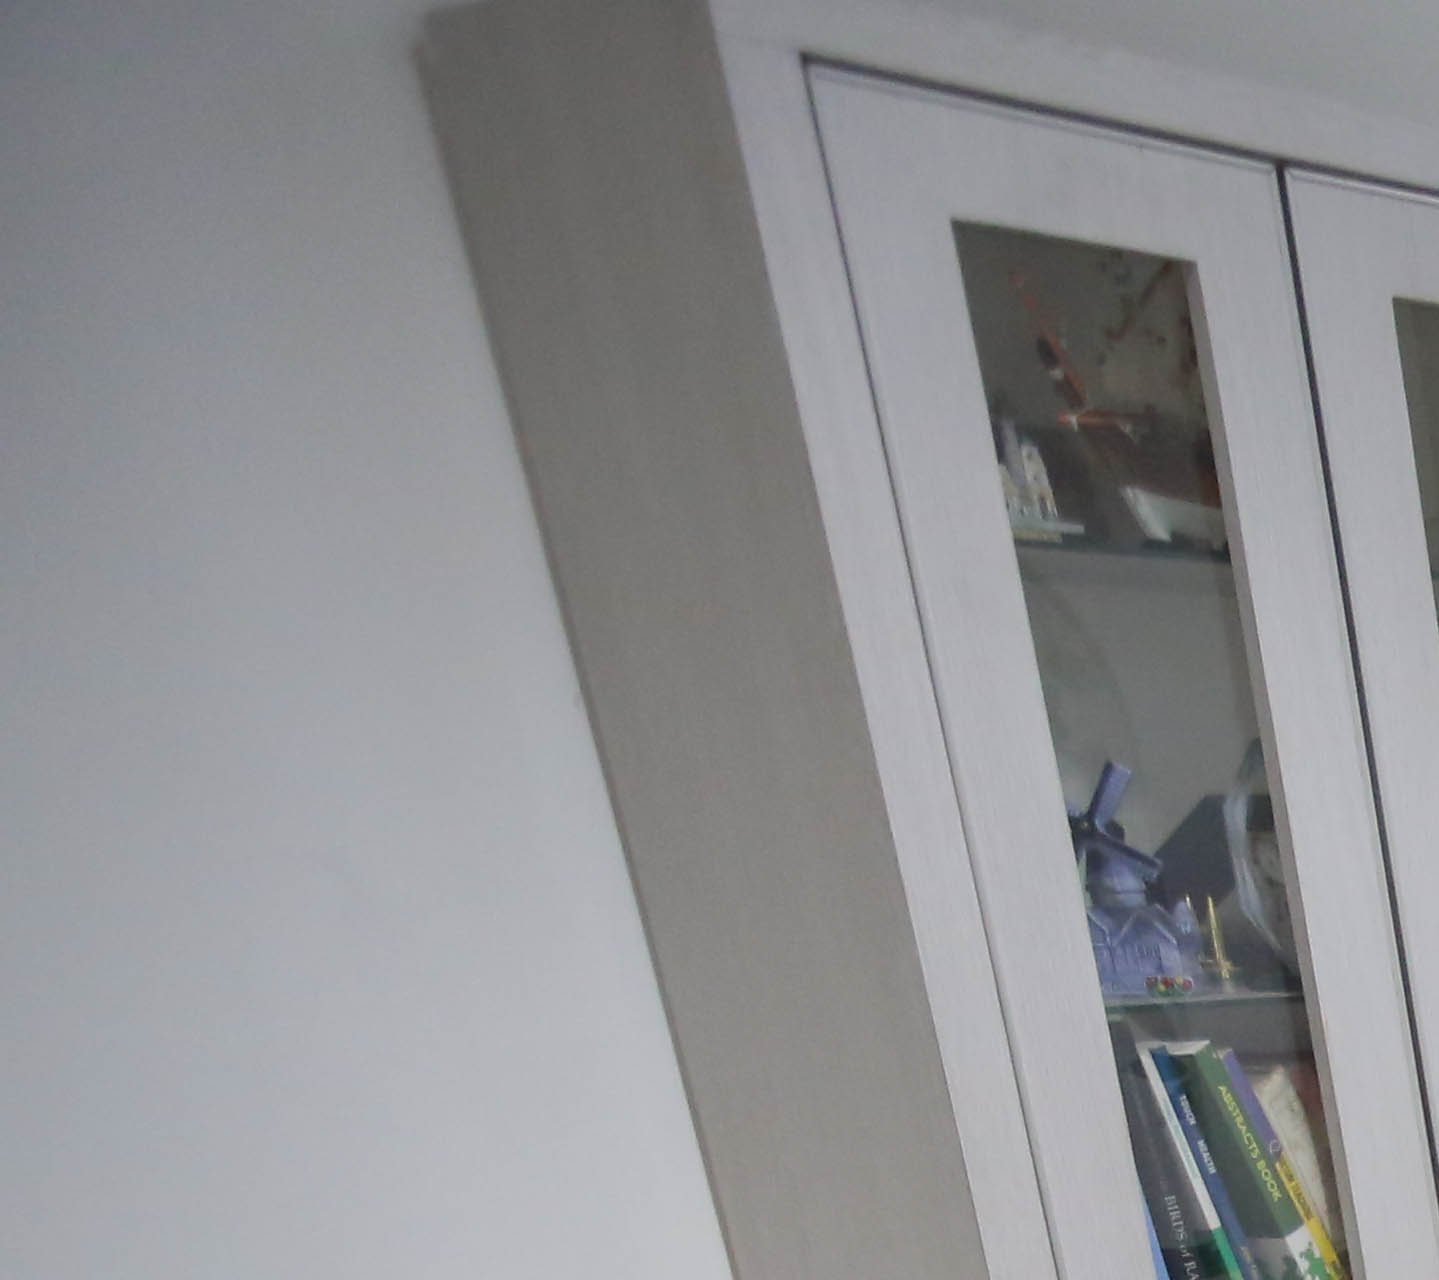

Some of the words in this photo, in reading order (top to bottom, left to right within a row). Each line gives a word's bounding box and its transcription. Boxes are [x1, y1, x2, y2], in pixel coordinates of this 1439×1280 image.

[1217, 1086, 1260, 1160] ABSTRACTS
[1256, 1158, 1283, 1203] BOOK
[1164, 1195, 1188, 1242] BIRDS
